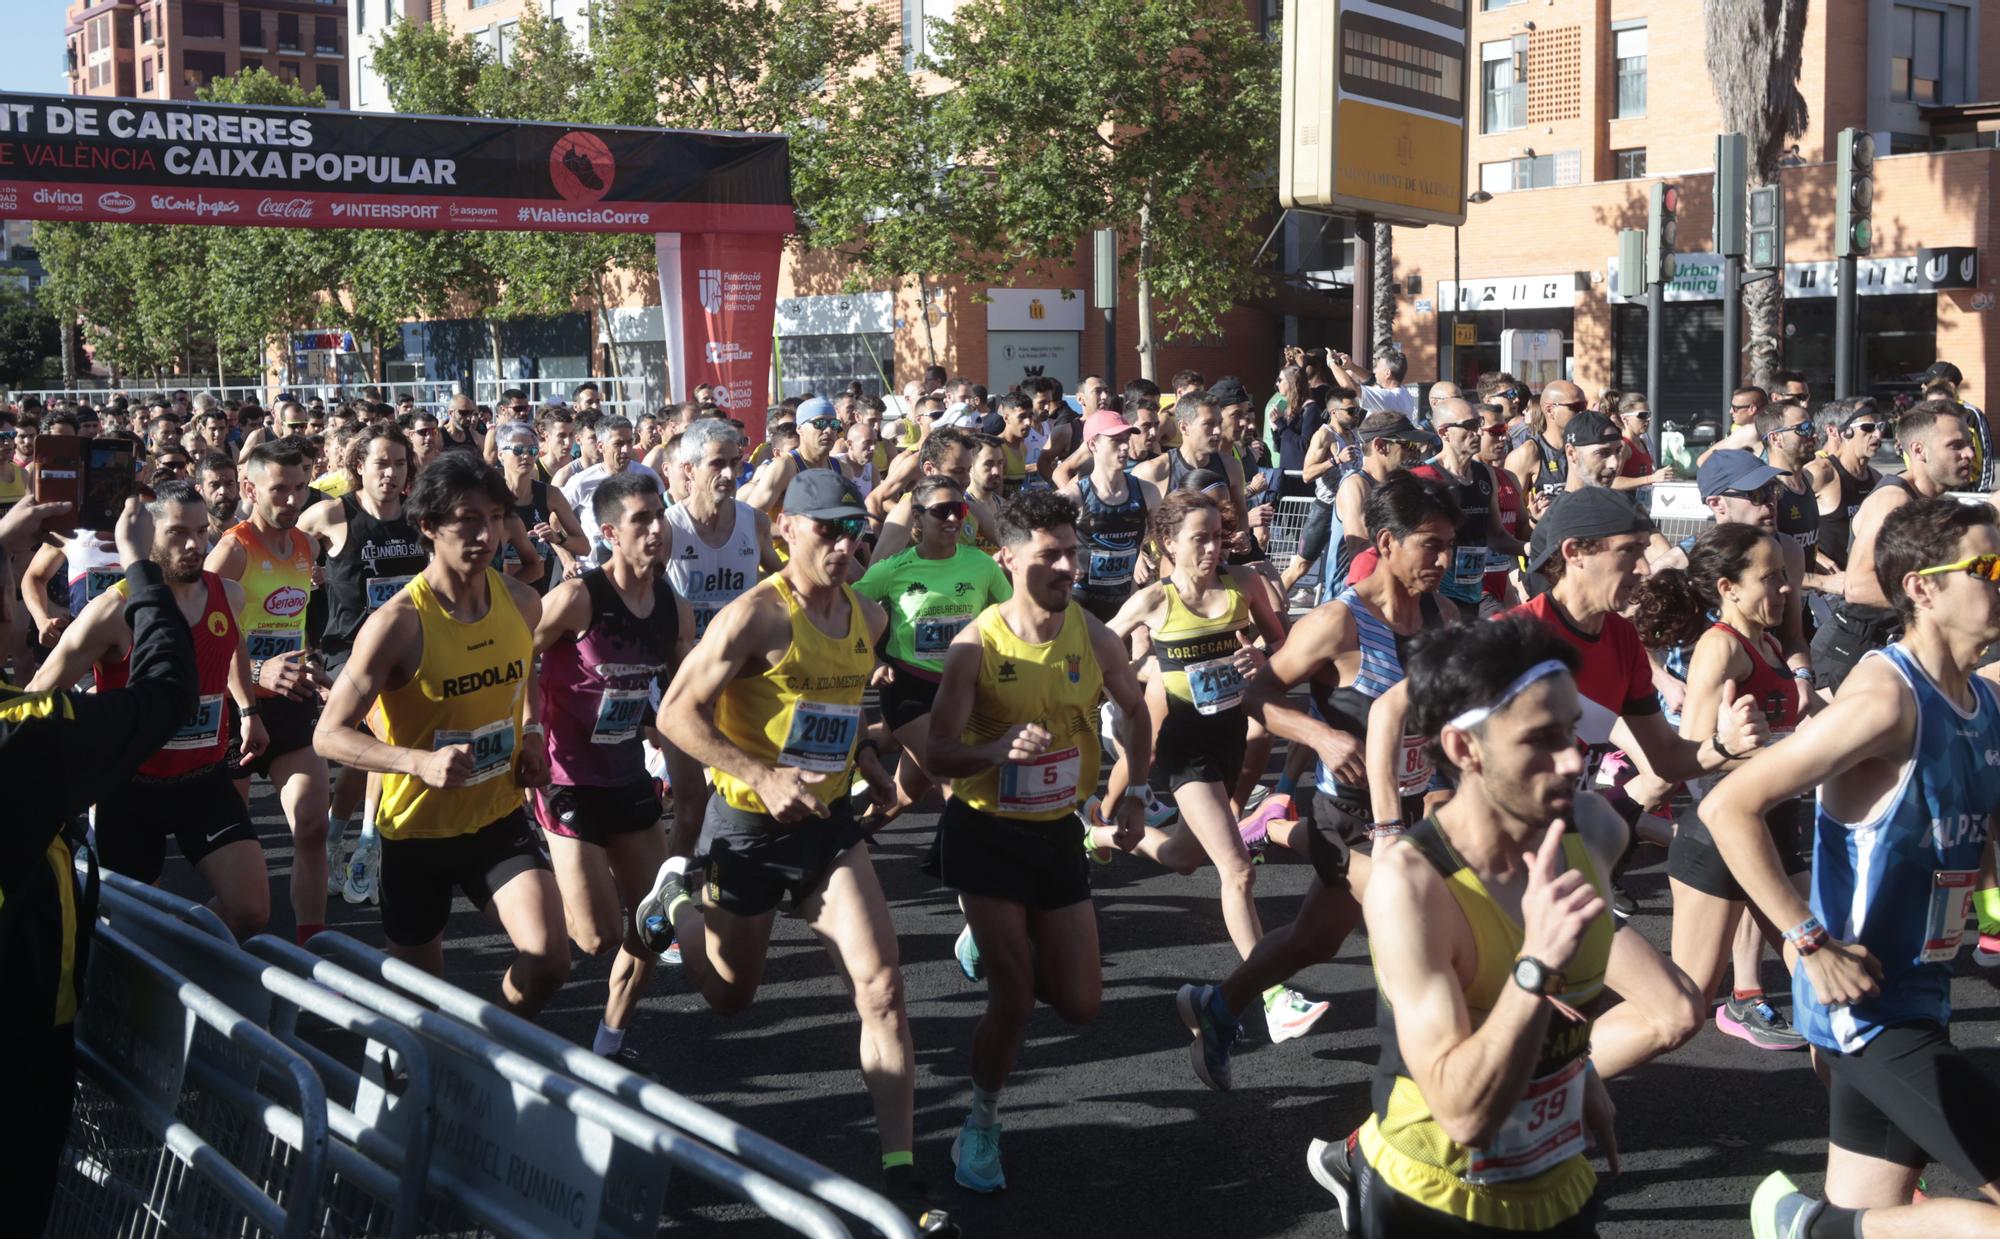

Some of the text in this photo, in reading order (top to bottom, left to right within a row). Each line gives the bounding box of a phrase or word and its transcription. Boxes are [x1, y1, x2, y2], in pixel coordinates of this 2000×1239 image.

[46, 106, 99, 137] DE
[107, 108, 313, 147] CARRERES
[23, 141, 156, 170] VALÈNCIA
[163, 147, 287, 179] CAIXA
[291, 152, 457, 186] POPULAR
[33, 189, 83, 205] divina
[151, 194, 165, 208] El
[165, 196, 195, 211] Corte
[346, 203, 439, 220] INTERSPORT
[458, 207, 498, 217] aspaym
[517, 207, 650, 225] #ValènciaCorre
[723, 271, 761, 281] Fundació
[1675, 263, 1719, 278] Urban
[723, 282, 761, 291] Esportiva
[723, 293, 761, 303] Municipal
[361, 543, 407, 560] ALEJANDRO
[1097, 557, 1130, 572] 2334
[688, 567, 745, 593] Delta
[268, 595, 306, 611] Serrano
[250, 637, 296, 657] 2520
[799, 714, 850, 745] 2091
[1042, 765, 1059, 786] 5
[1527, 1087, 1569, 1132] 39
